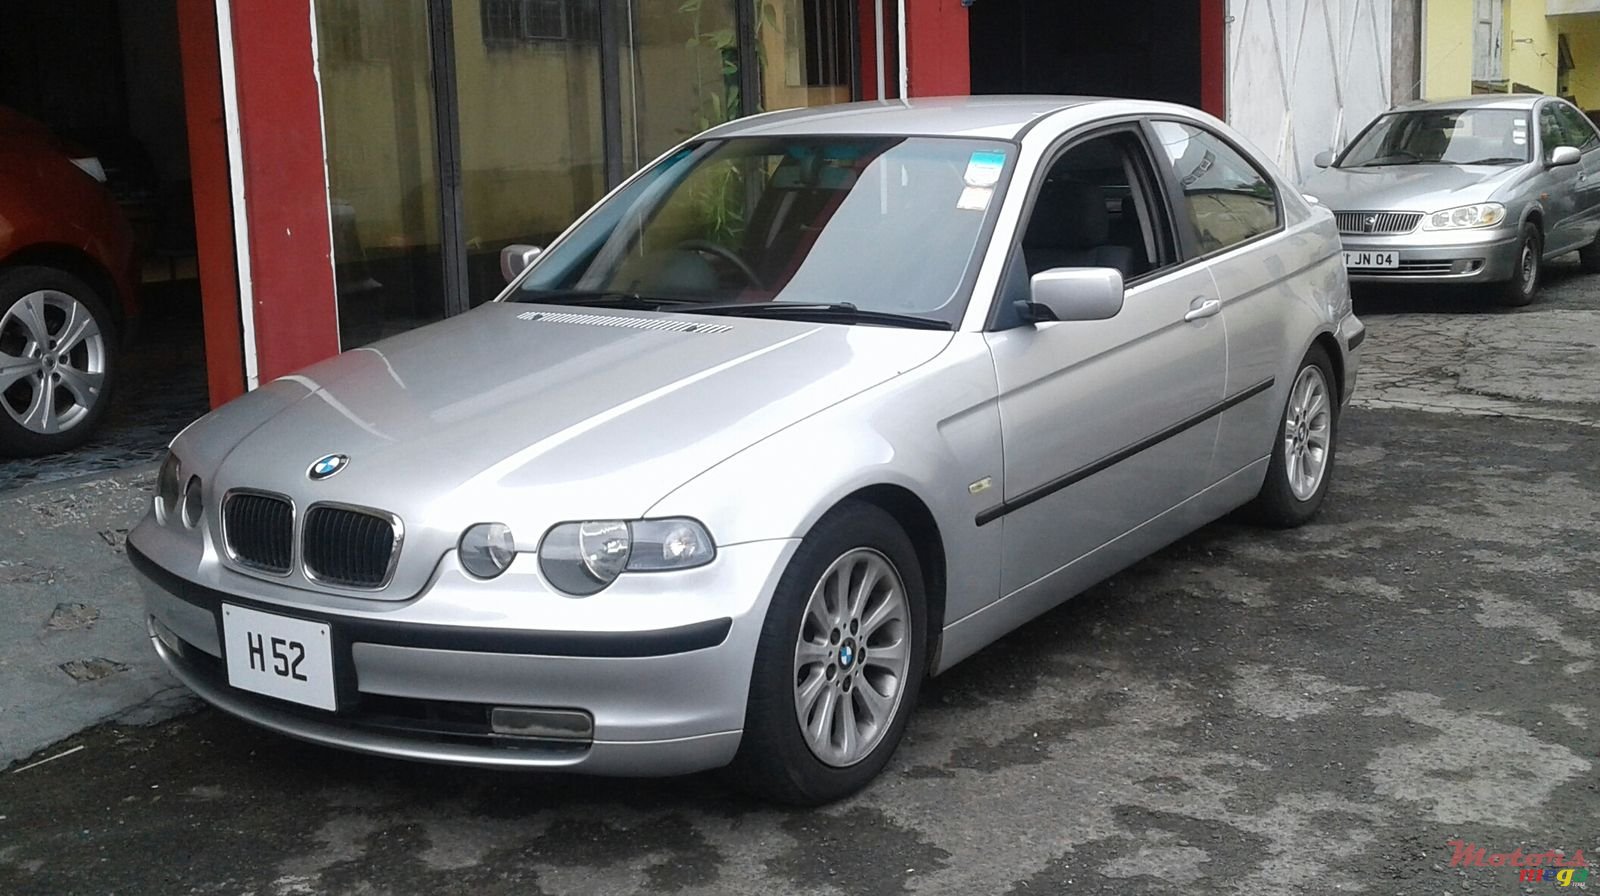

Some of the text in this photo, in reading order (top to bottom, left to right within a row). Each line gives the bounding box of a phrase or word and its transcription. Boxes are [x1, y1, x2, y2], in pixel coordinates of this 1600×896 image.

[1355, 253, 1371, 265] JN
[1376, 253, 1392, 265] 04
[247, 631, 308, 682] H 52
